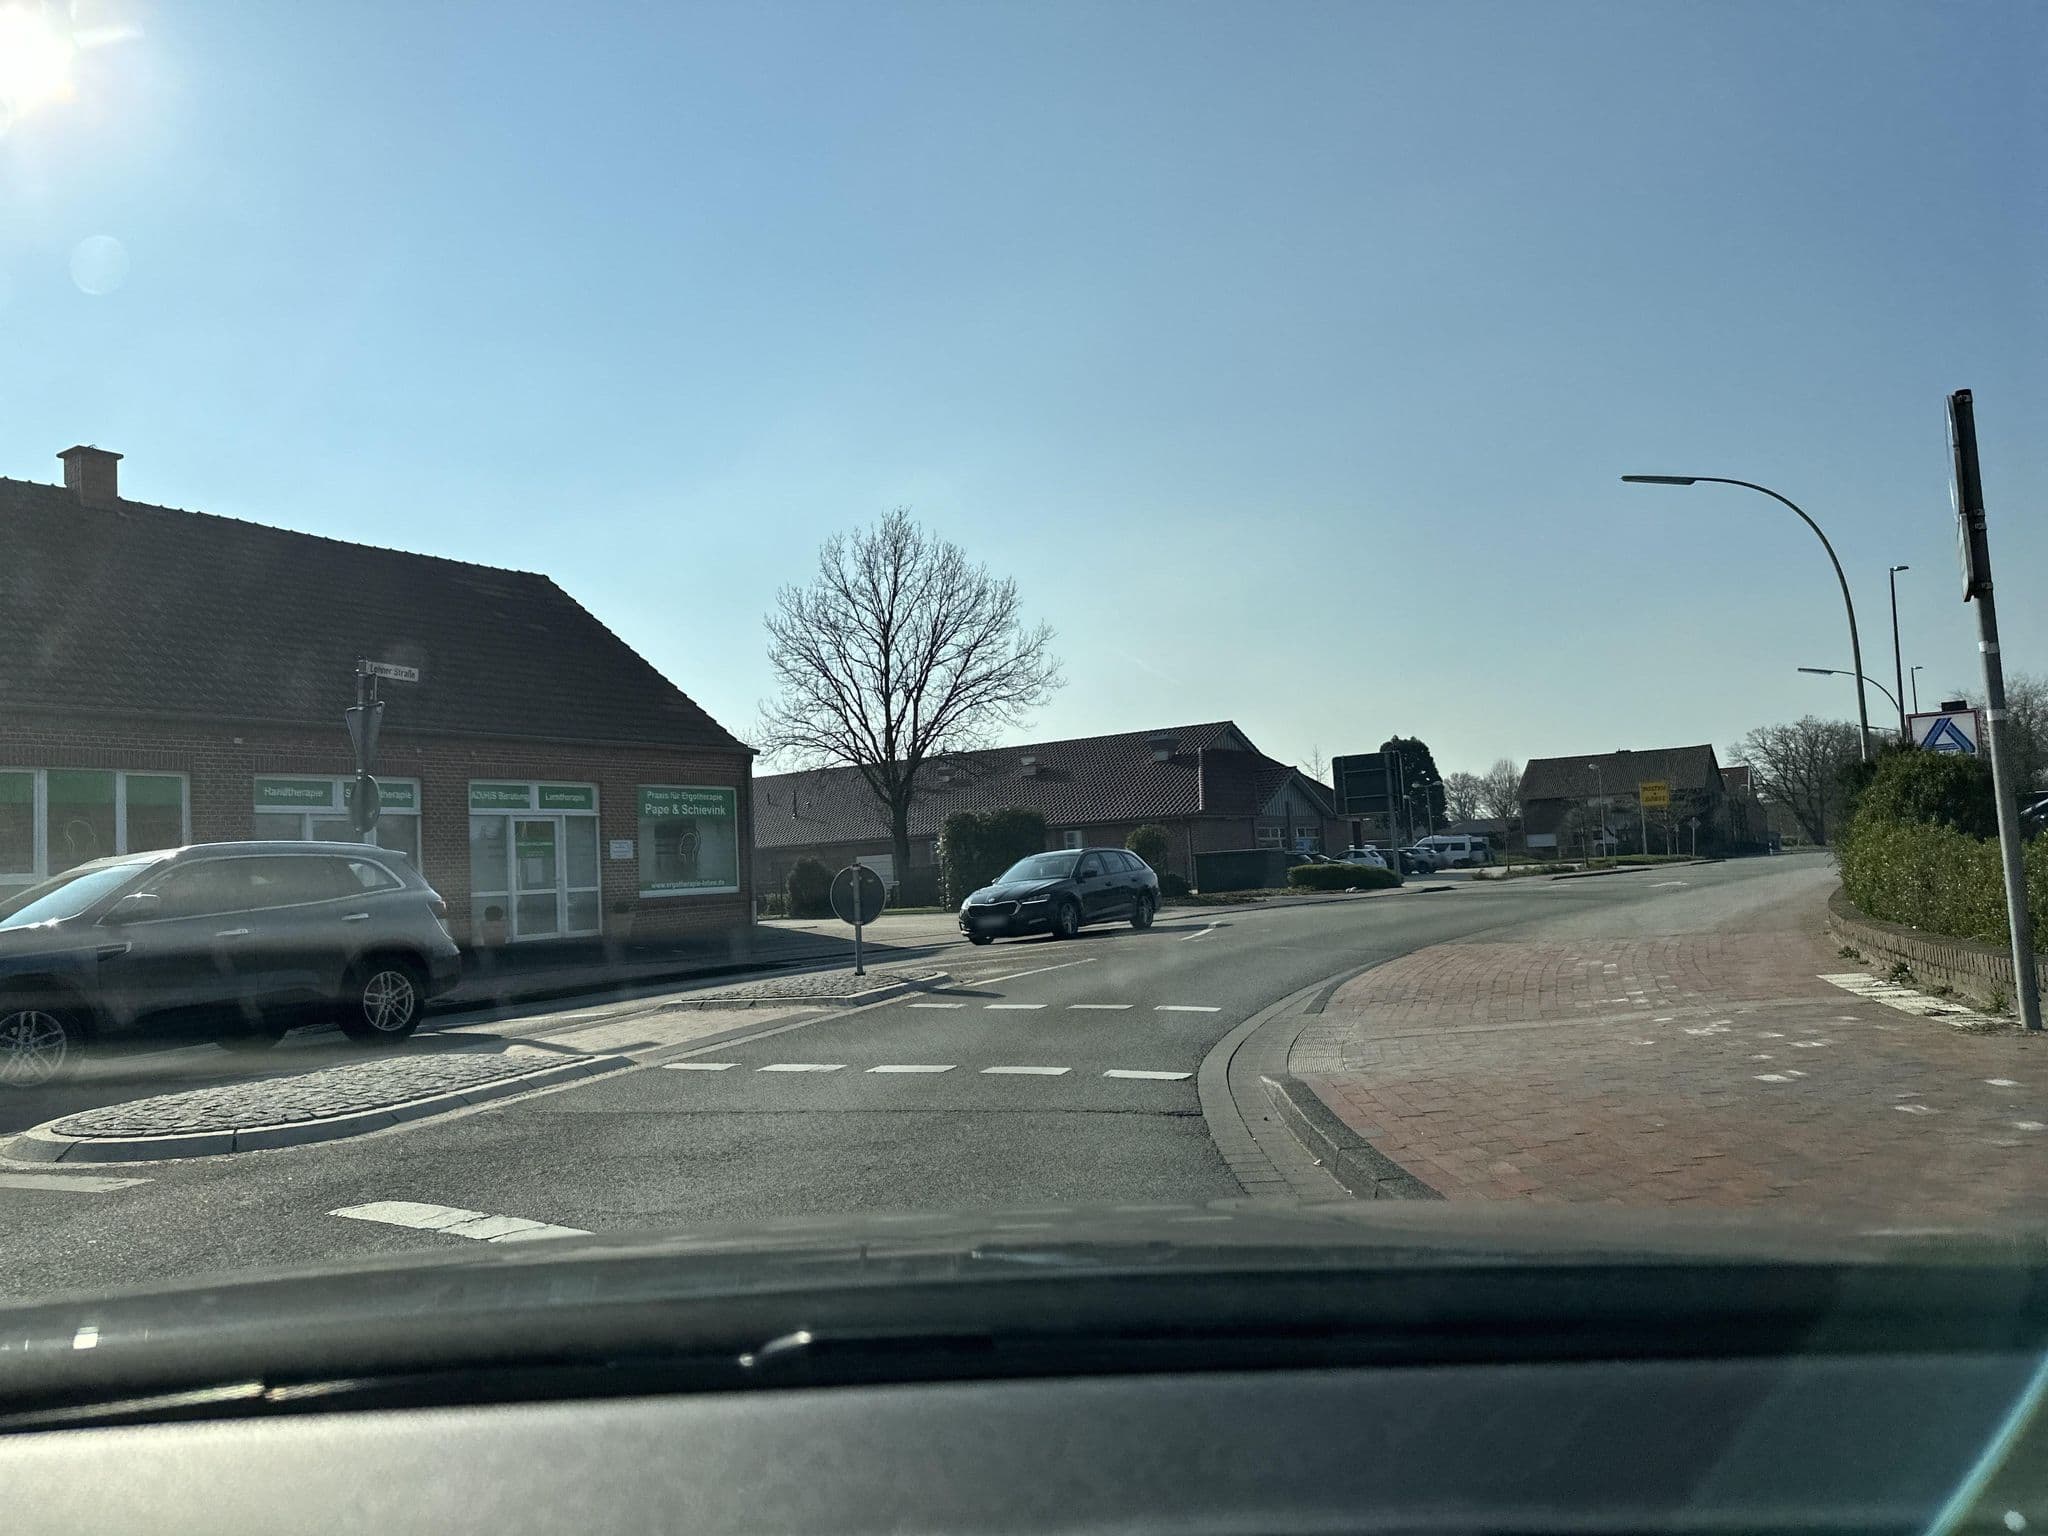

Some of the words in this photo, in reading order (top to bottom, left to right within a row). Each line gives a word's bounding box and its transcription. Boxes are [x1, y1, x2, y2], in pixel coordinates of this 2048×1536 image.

[393, 667, 416, 679] Straße
[264, 786, 323, 799] Handtherapie
[647, 790, 669, 799] Praxis
[670, 791, 681, 800] für
[681, 792, 723, 802] Ergotherapie
[645, 803, 669, 816] Pape
[672, 803, 680, 815] &
[681, 804, 726, 816] Schievink
